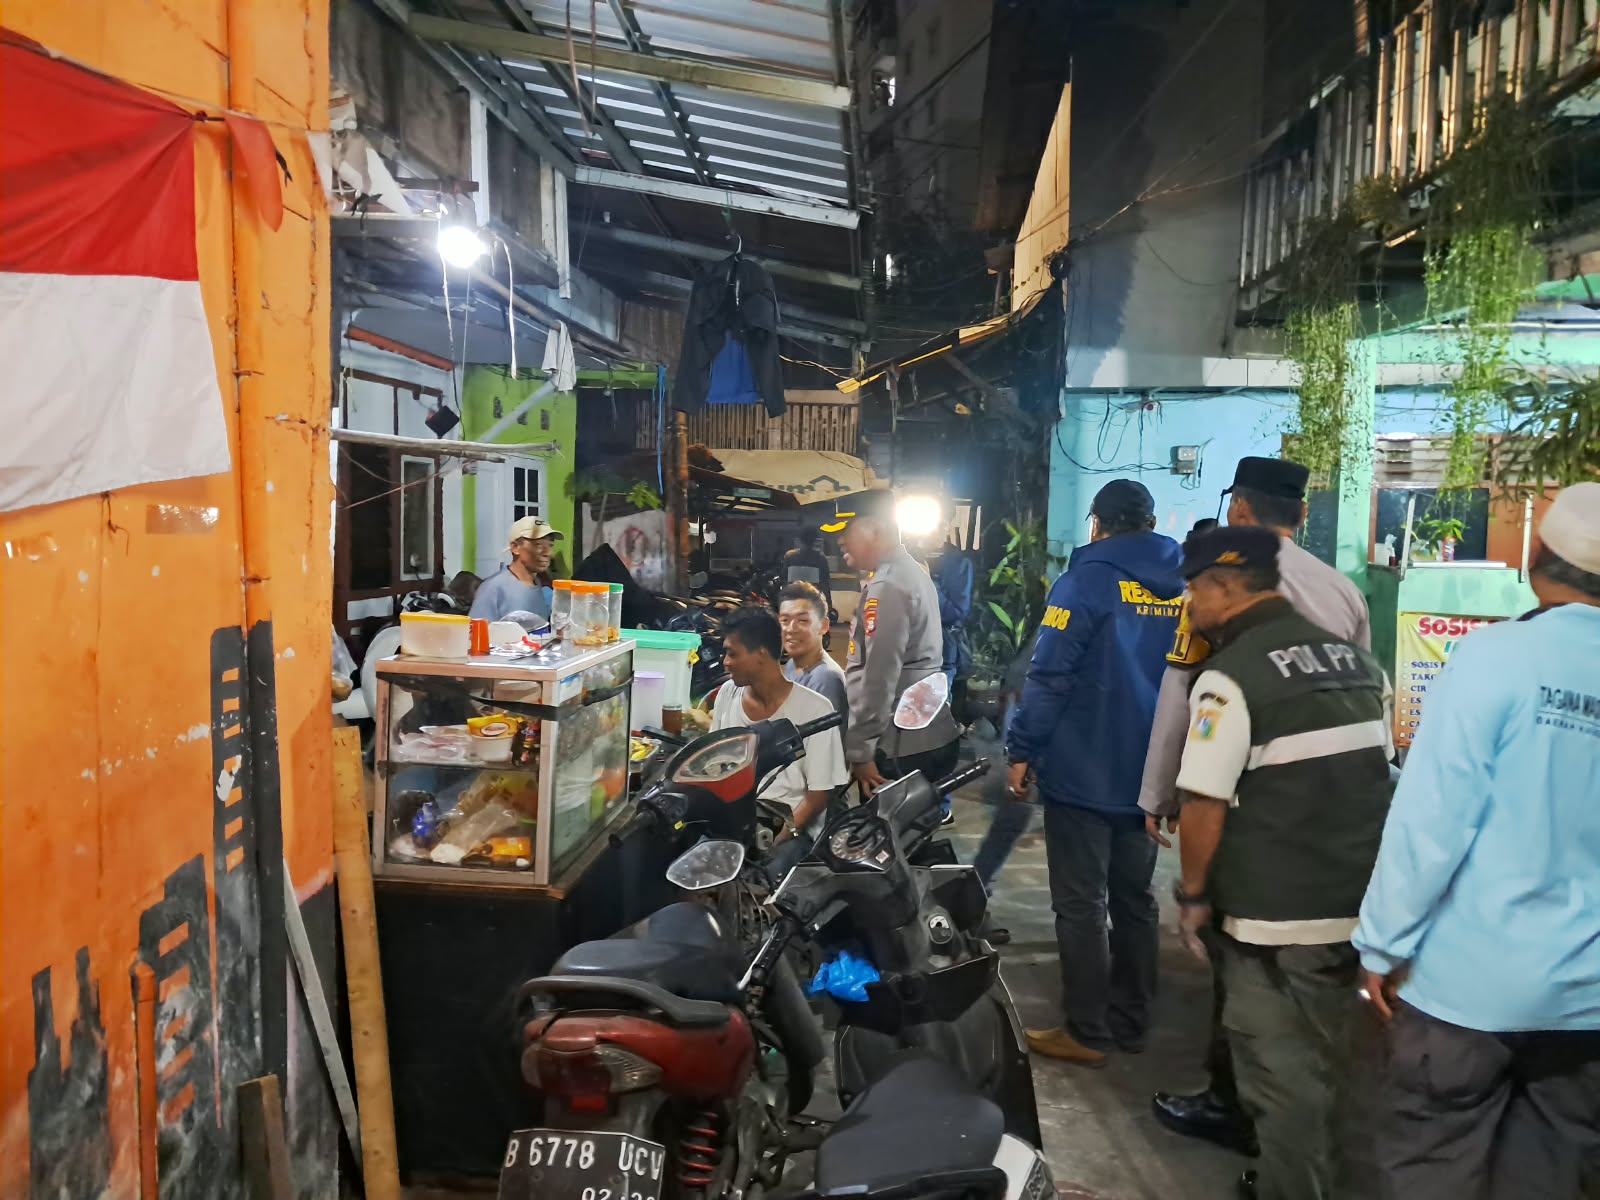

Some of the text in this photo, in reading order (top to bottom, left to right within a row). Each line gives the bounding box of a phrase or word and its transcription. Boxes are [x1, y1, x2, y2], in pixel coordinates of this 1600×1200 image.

[1267, 643, 1356, 678] POL PP
[1411, 661, 1438, 669] SOSIS
[504, 1137, 663, 1181] B 6778 UCV
